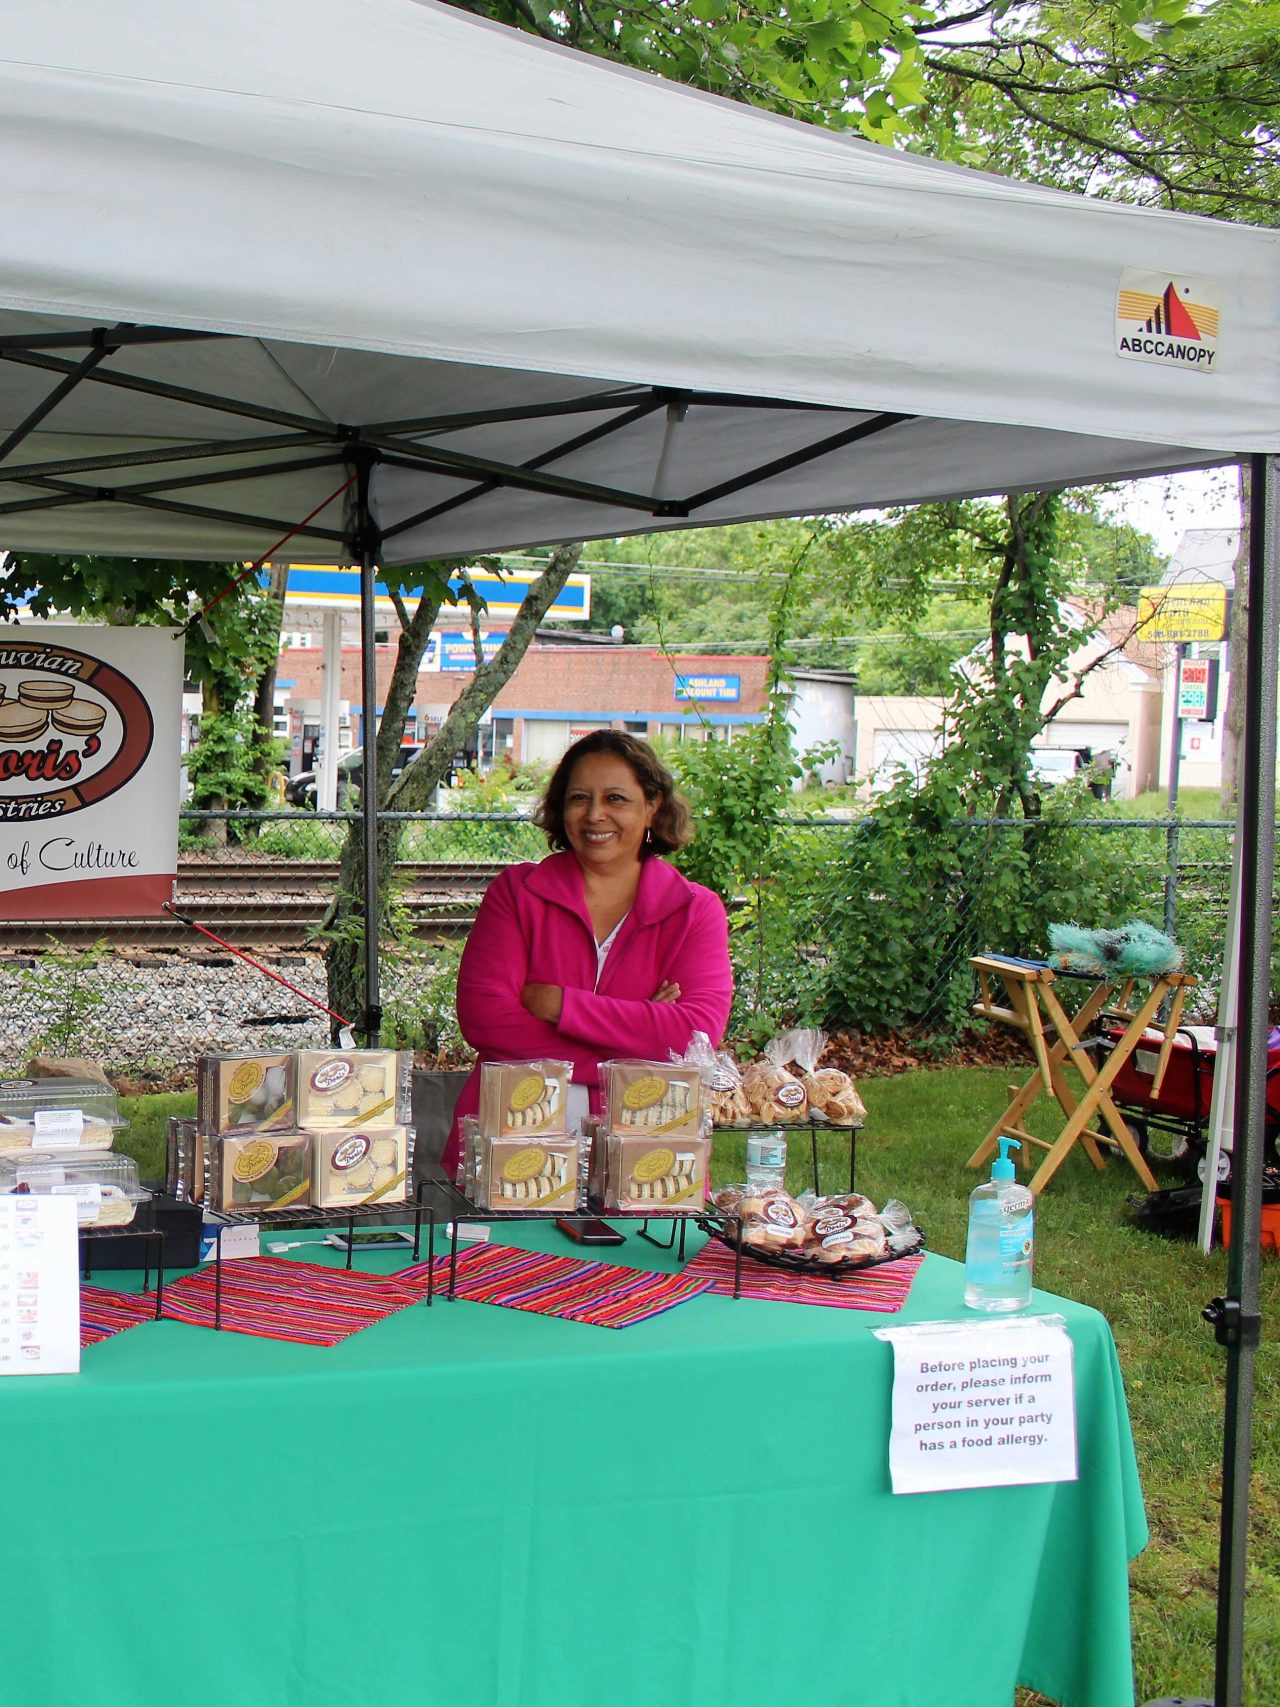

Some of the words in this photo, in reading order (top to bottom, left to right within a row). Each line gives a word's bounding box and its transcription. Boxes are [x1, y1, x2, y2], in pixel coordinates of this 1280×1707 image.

[1120, 338, 1215, 365] ABCCANOPY
[7, 842, 31, 876] of
[39, 837, 139, 871] Culture
[920, 1362, 965, 1374] Before
[969, 1357, 1017, 1372] placing
[1021, 1353, 1050, 1368] your
[916, 1381, 956, 1393] order,
[961, 1376, 1006, 1392] please
[1010, 1372, 1052, 1384] inform
[932, 1400, 963, 1413] your
[967, 1396, 1010, 1408] server
[1014, 1393, 1023, 1404] if
[1028, 1394, 1036, 1404] a
[914, 1418, 961, 1434] person
[966, 1417, 978, 1427] in
[983, 1414, 1013, 1429] your
[1018, 1412, 1053, 1426] party
[920, 1440, 944, 1451] has
[949, 1440, 957, 1448] a
[962, 1436, 992, 1447] food
[997, 1433, 1048, 1446] allergy.
